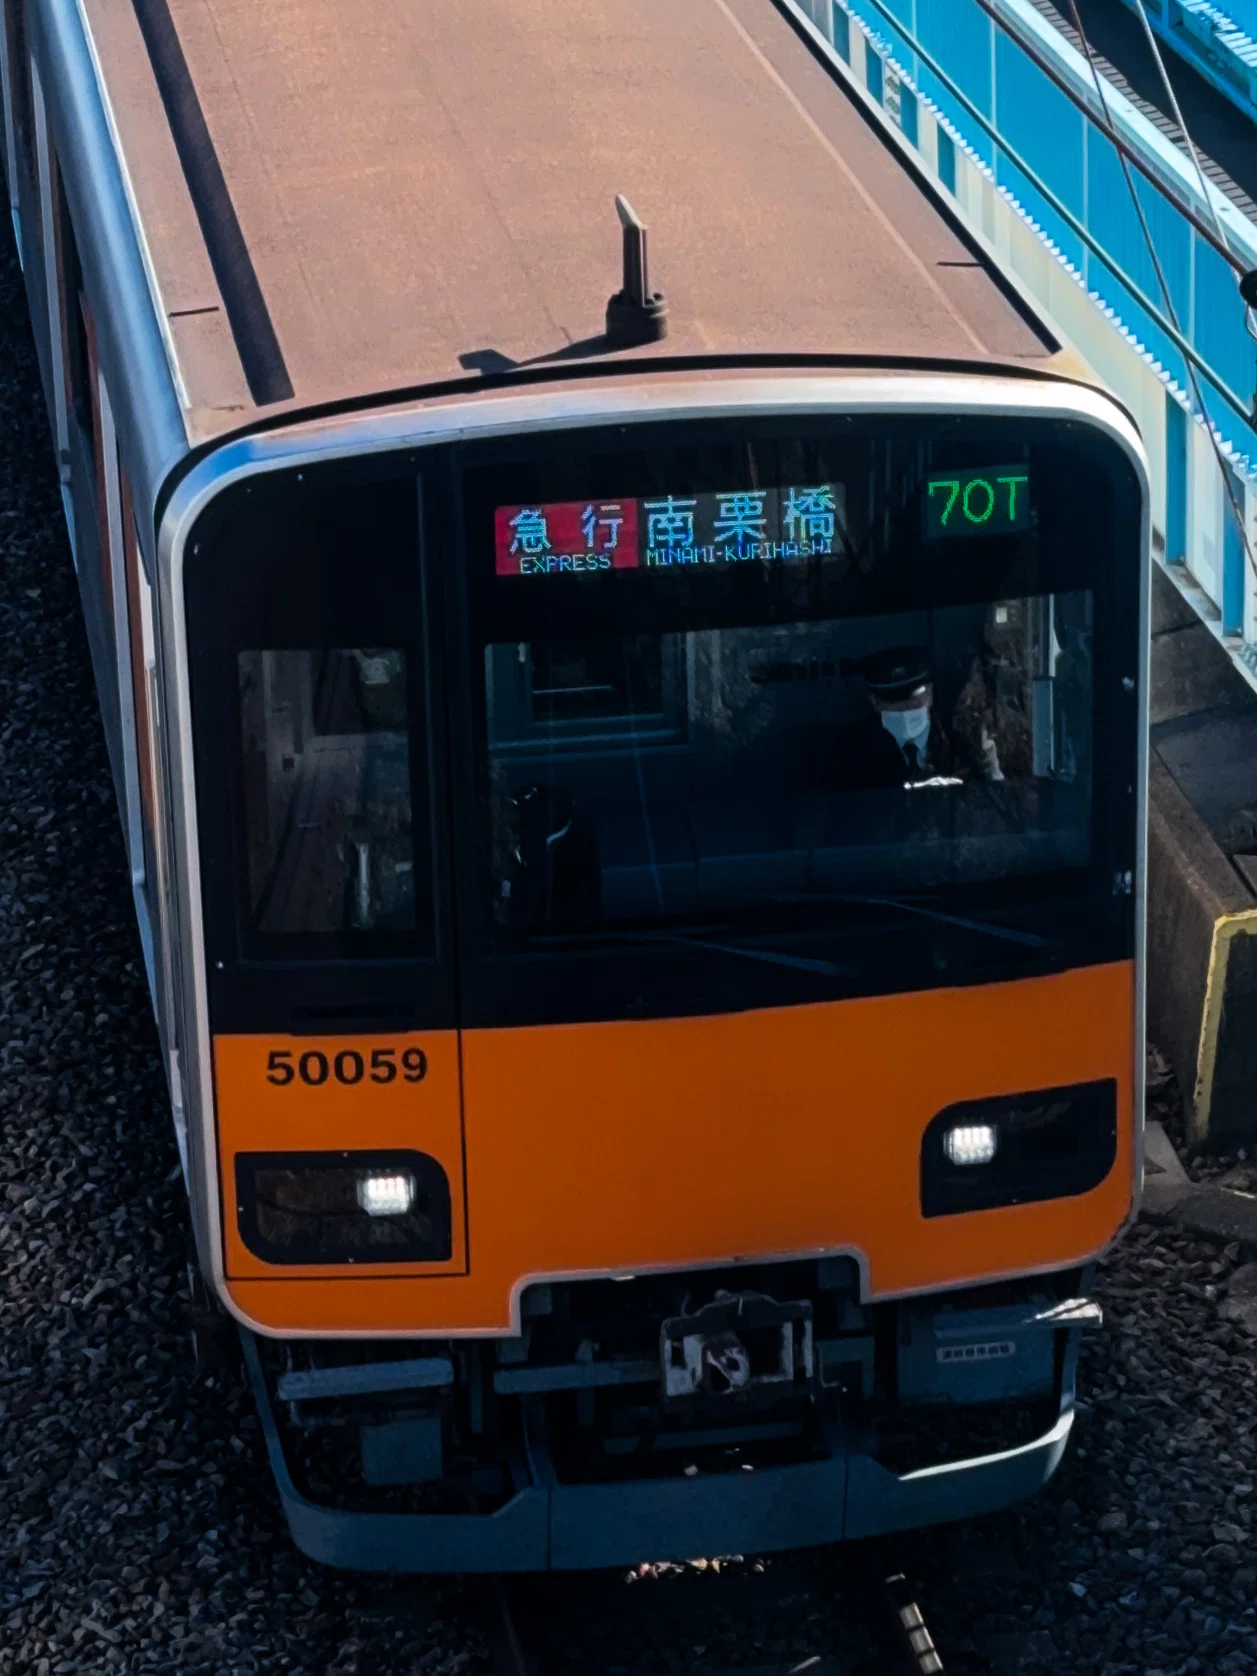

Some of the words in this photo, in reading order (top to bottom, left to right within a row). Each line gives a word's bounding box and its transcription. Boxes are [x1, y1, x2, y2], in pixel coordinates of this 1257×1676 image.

[645, 486, 836, 549] 南栗橋
[928, 476, 1028, 526] 70T
[510, 505, 623, 552] 急行
[519, 554, 612, 574] EXPRESS
[266, 1047, 428, 1086] 50059
